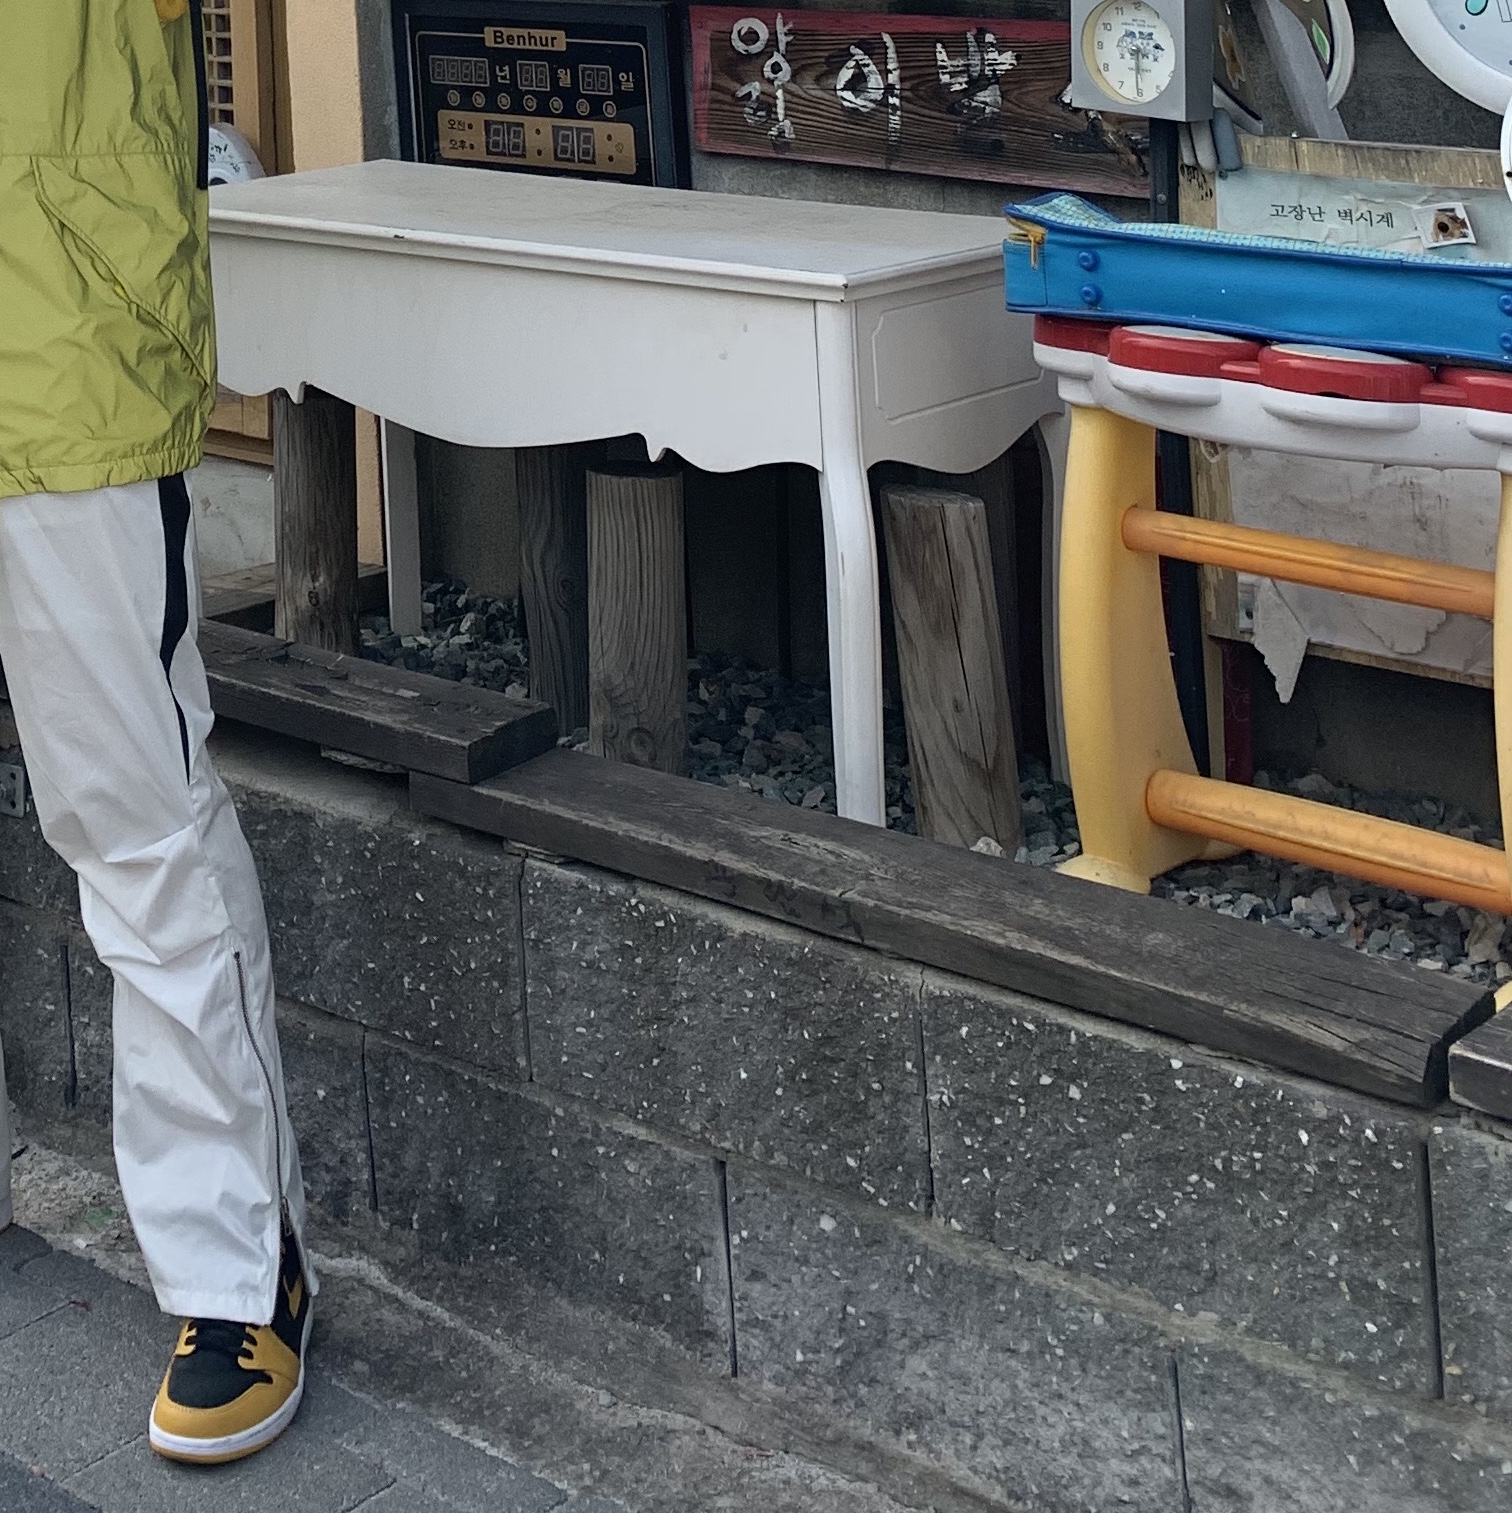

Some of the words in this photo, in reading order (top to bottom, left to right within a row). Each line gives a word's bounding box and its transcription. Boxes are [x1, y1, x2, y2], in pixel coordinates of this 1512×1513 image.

[1115, 7, 1124, 15] 11
[1132, 2, 1141, 11] 12
[1102, 22, 1112, 31] 10
[493, 30, 557, 48] Benhur
[495, 65, 511, 84] 년
[557, 68, 571, 87] 월
[618, 71, 635, 91] 일
[447, 119, 466, 131] 오전
[449, 139, 467, 151] 오후
[1269, 204, 1326, 223] 고장난
[1337, 209, 1395, 229] 벽시계
